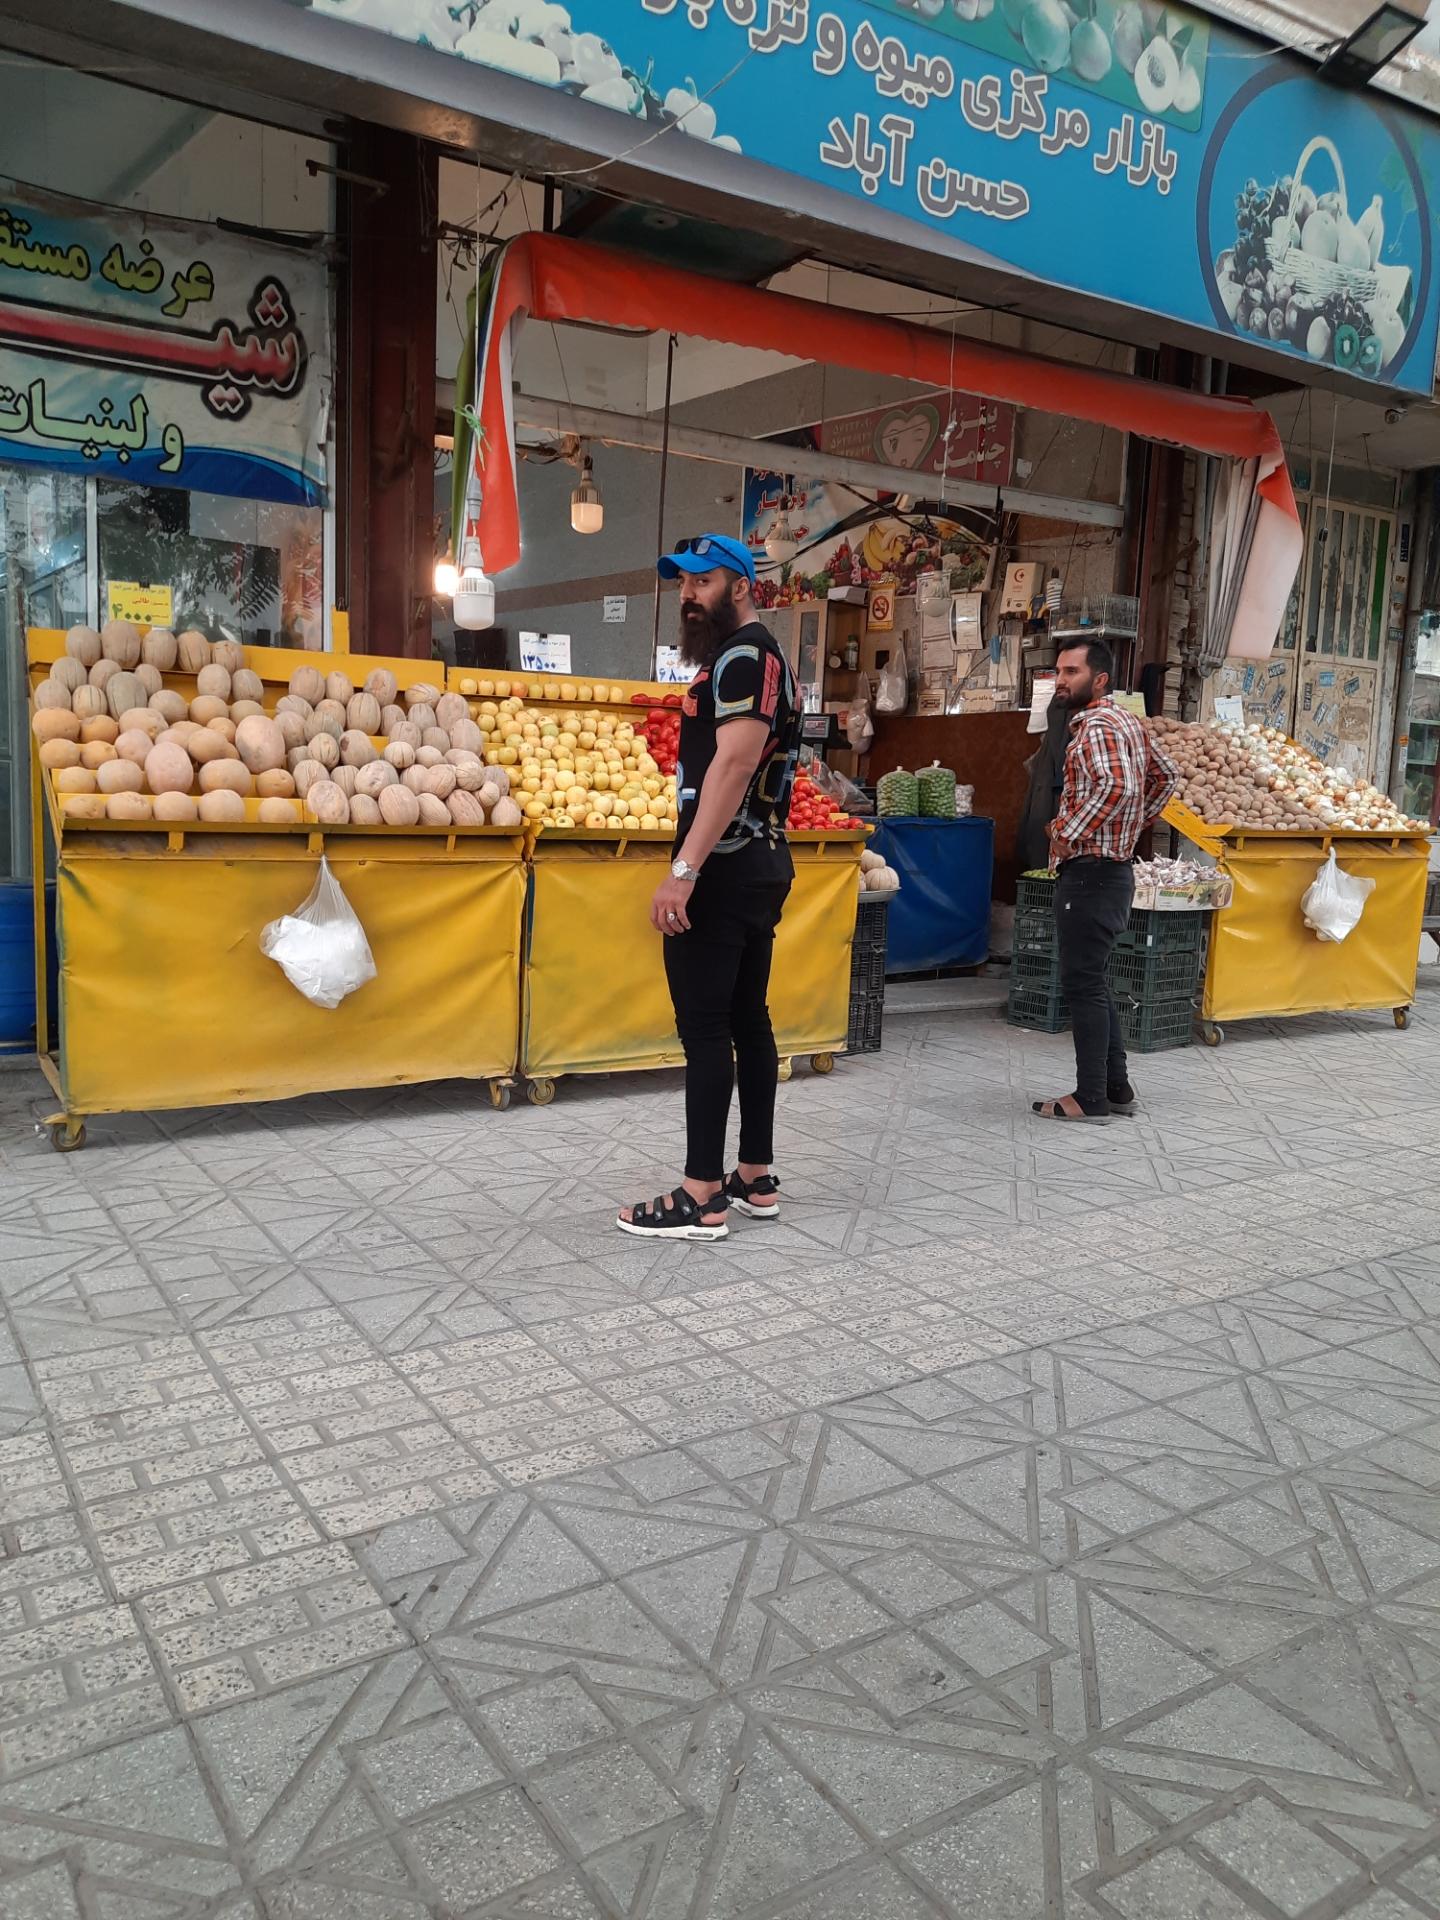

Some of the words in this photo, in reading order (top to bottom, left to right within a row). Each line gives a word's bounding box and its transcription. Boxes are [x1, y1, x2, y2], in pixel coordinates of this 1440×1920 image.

[813, 13, 846, 75] و
[852, 21, 953, 108] میوه
[960, 69, 1090, 155] مرکزی
[820, 113, 914, 195] آباد
[918, 158, 1029, 220] حسن
[1093, 113, 1177, 195] بازار
[100, 239, 215, 317] عرضه
[157, 423, 184, 473] و
